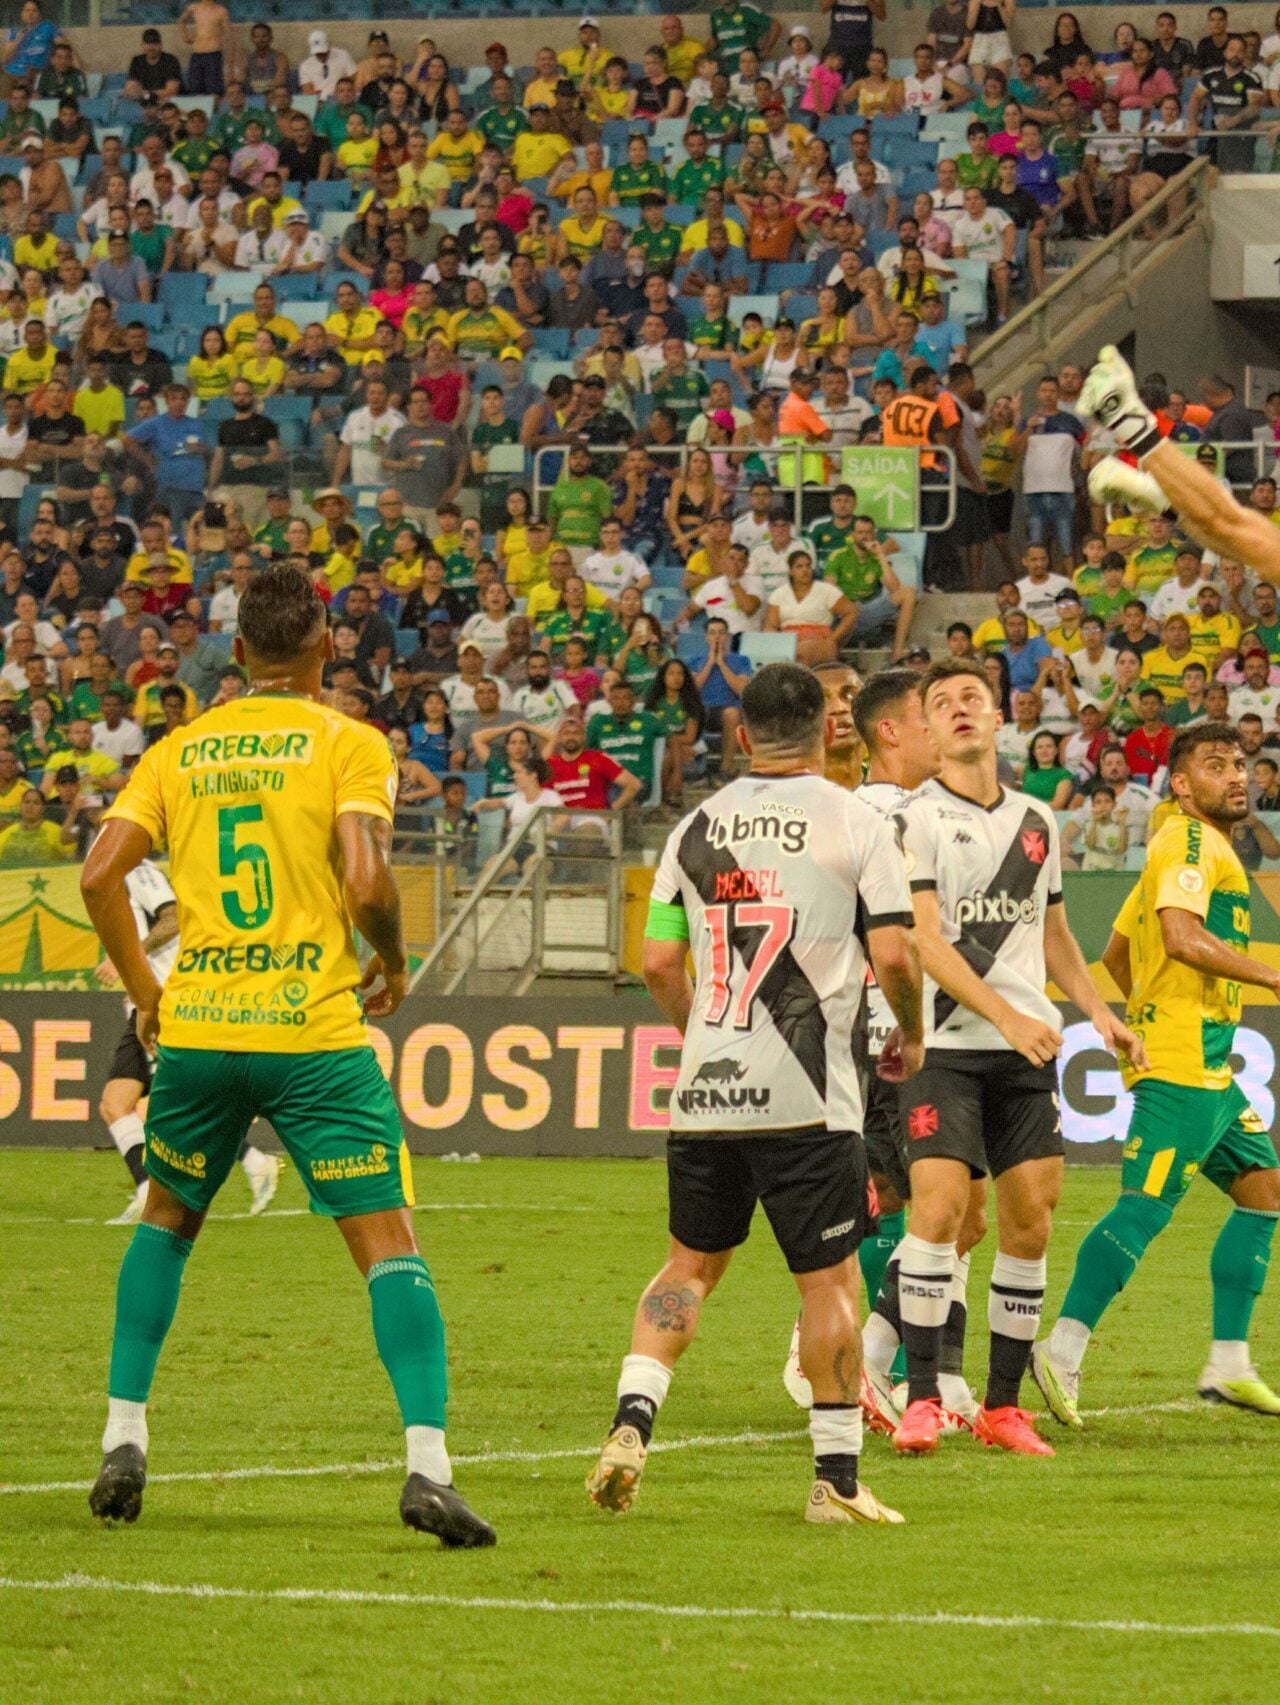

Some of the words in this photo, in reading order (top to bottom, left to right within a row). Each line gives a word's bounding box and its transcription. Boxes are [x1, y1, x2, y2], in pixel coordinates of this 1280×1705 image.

[180, 733, 308, 768] DREBOR
[761, 802, 803, 816] VASCO
[731, 813, 809, 857] bmg
[217, 803, 274, 931] 5
[714, 869, 785, 900] MEDEL
[177, 941, 324, 974] DREBOR
[704, 902, 798, 1032] 17
[174, 1003, 222, 1023] MATO
[226, 1008, 307, 1027] GROSSO
[312, 1168, 342, 1181] MATO
[345, 1162, 389, 1178] GROSSO
